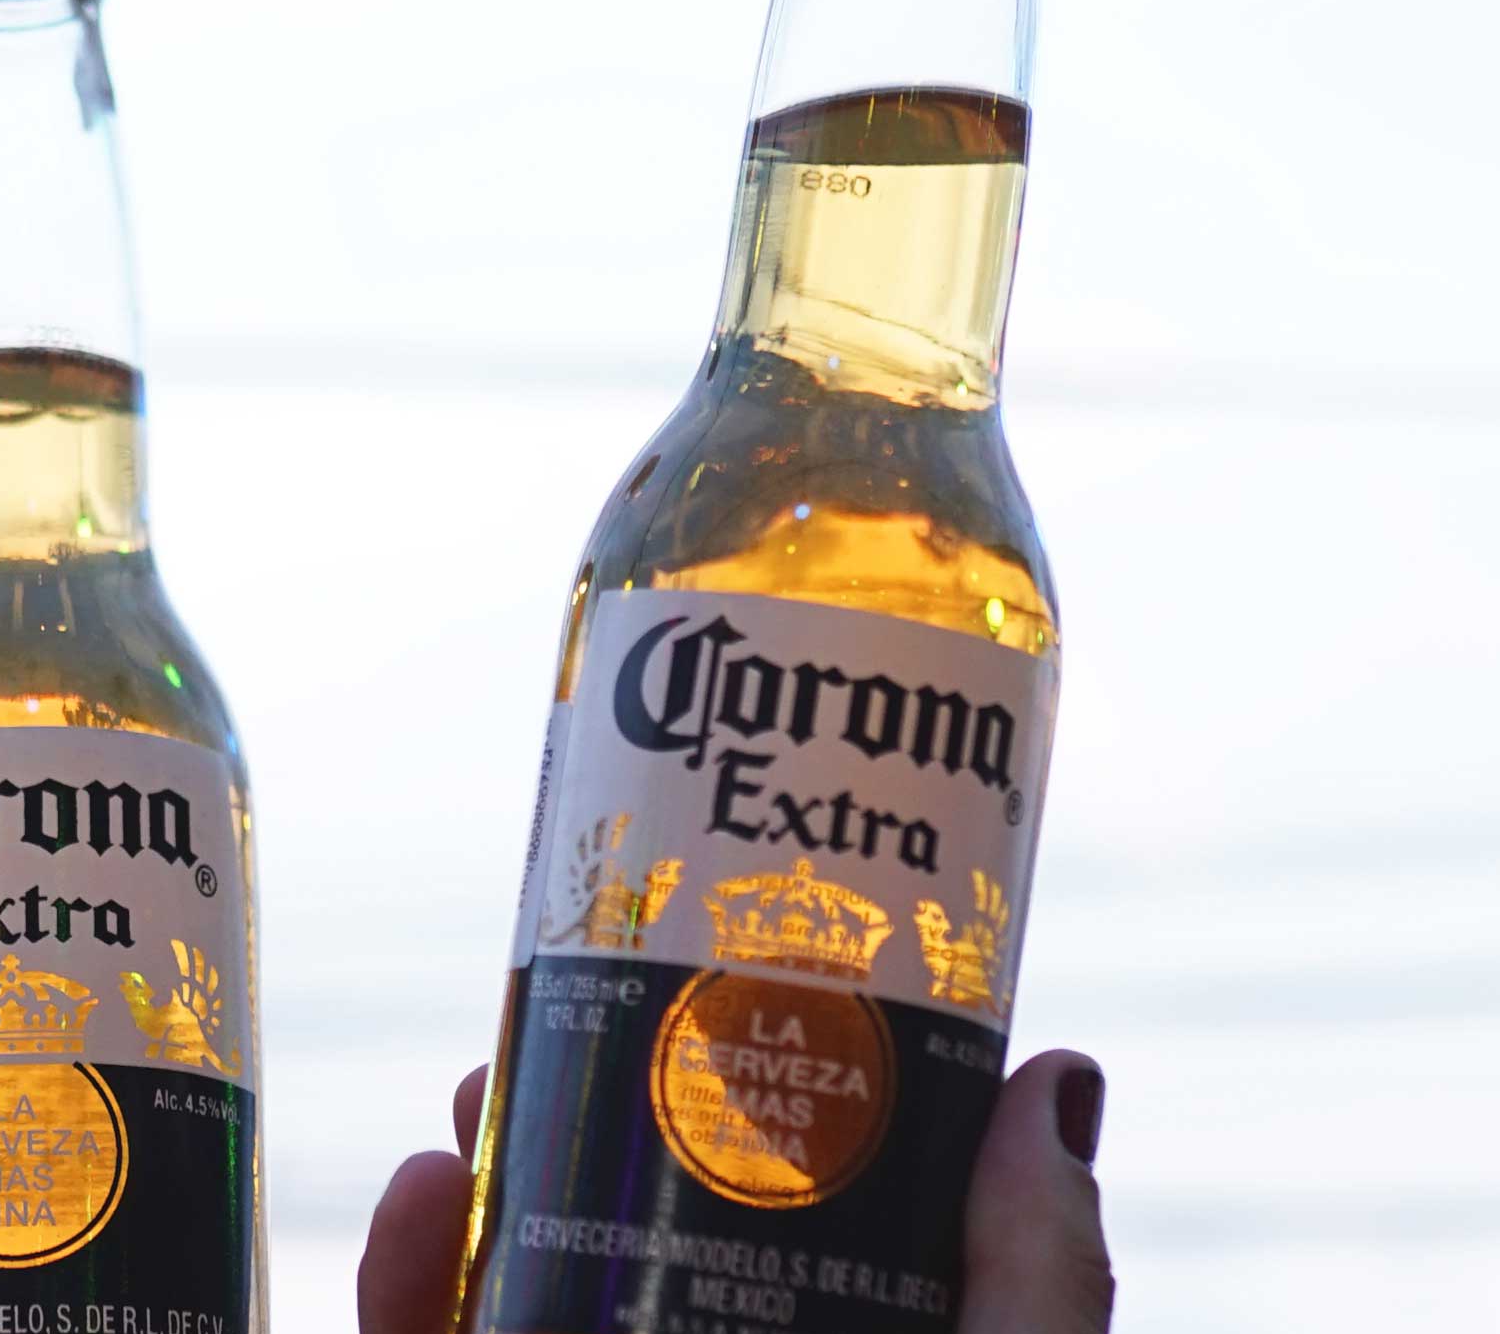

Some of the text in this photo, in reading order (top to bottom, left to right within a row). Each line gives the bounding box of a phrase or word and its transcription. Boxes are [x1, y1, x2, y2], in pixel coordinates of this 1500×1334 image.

[613, 614, 1017, 794] Corona
[705, 747, 940, 875] Extra
[751, 1009, 807, 1050] LA
[679, 1040, 869, 1102] CERVEZA
[154, 1088, 182, 1112] Alc.
[185, 1093, 220, 1120] 4.5%
[726, 1085, 815, 1130] MAS
[518, 1213, 660, 1259] CERVECERIA
[818, 1255, 849, 1296] DE
[56, 1304, 79, 1334] S.
[86, 1305, 116, 1334] DE
[689, 1275, 796, 1325] MEXICO
